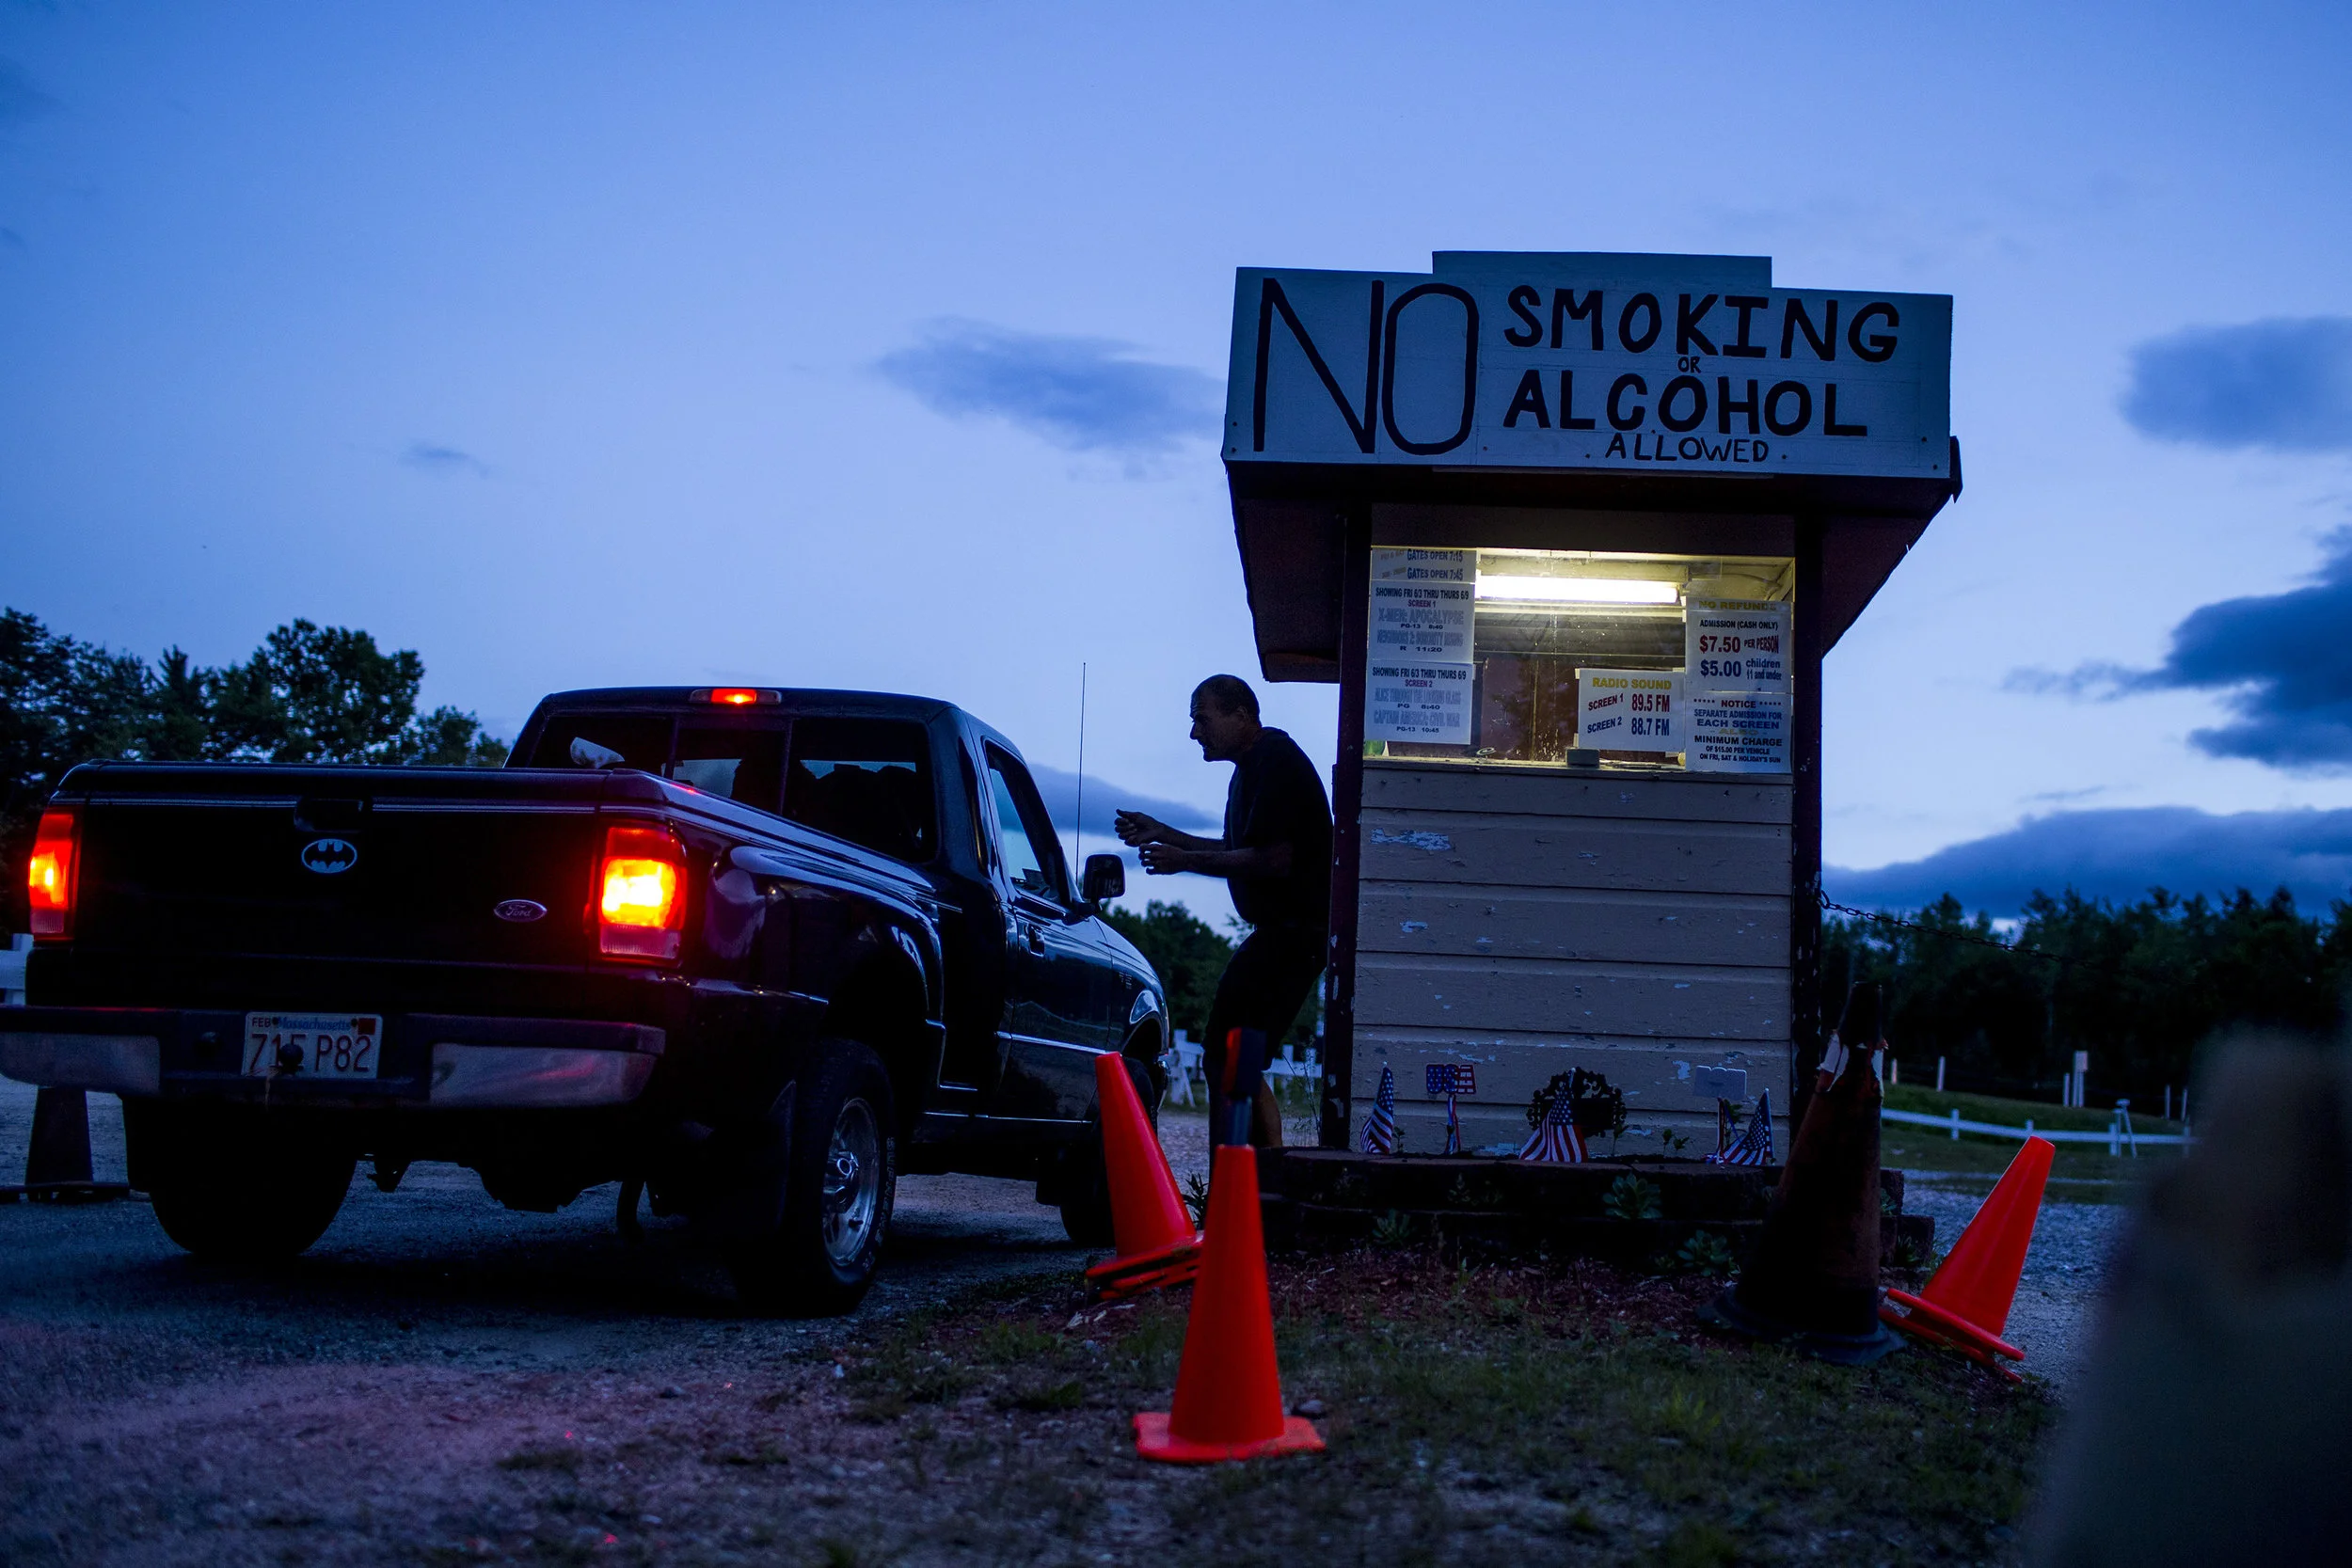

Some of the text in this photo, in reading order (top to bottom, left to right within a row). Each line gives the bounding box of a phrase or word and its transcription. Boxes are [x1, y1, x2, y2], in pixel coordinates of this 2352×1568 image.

[1503, 285, 1900, 363] SMOKING
[1252, 277, 1480, 456] NO
[1677, 356, 1702, 373] OR
[1503, 369, 1868, 437] ALCOHOL
[1604, 437, 1770, 464] ALLOWED
[1407, 549, 1428, 561] GATES
[1430, 551, 1447, 561] OPEN
[1450, 551, 1463, 562] 7:15
[1407, 568, 1428, 579] GATES
[1430, 570, 1447, 579] OPEN
[1450, 569, 1463, 580] 7:45
[1376, 587, 1402, 597] SHOWING
[1404, 589, 1412, 597] FRI
[1423, 590, 1438, 598] THRU
[1440, 591, 1459, 599] THURS
[1737, 621, 1756, 629] (CASH
[1758, 622, 1778, 630] ONLY)
[1700, 635, 1779, 654] $7.50 PER PERSON
[1373, 667, 1399, 677] SHOWING
[1401, 669, 1409, 677] FRI
[1421, 669, 1437, 678] THRU
[1438, 670, 1456, 679] THURS
[1700, 658, 1781, 677] $5.00 children
[1755, 670, 1764, 679] and
[1766, 671, 1782, 680] under
[1593, 677, 1672, 689] RADIO SOUND
[1588, 693, 1670, 712] SCREEN 1 89.5 FM
[1721, 700, 1756, 708] NOTICE
[1694, 709, 1782, 721] SEPARATE ADMISSION FOR
[1587, 716, 1669, 736] SCREEN 2 88.7 FM
[1697, 719, 1779, 729] EACH SCREEN
[1694, 736, 1782, 746] MINIMUM CHARGE
[506, 905, 532, 916] Ford
[252, 1017, 351, 1030] FEB Massachusetts
[315, 1035, 372, 1072] P82
[1426, 1064, 1477, 1094] USA
